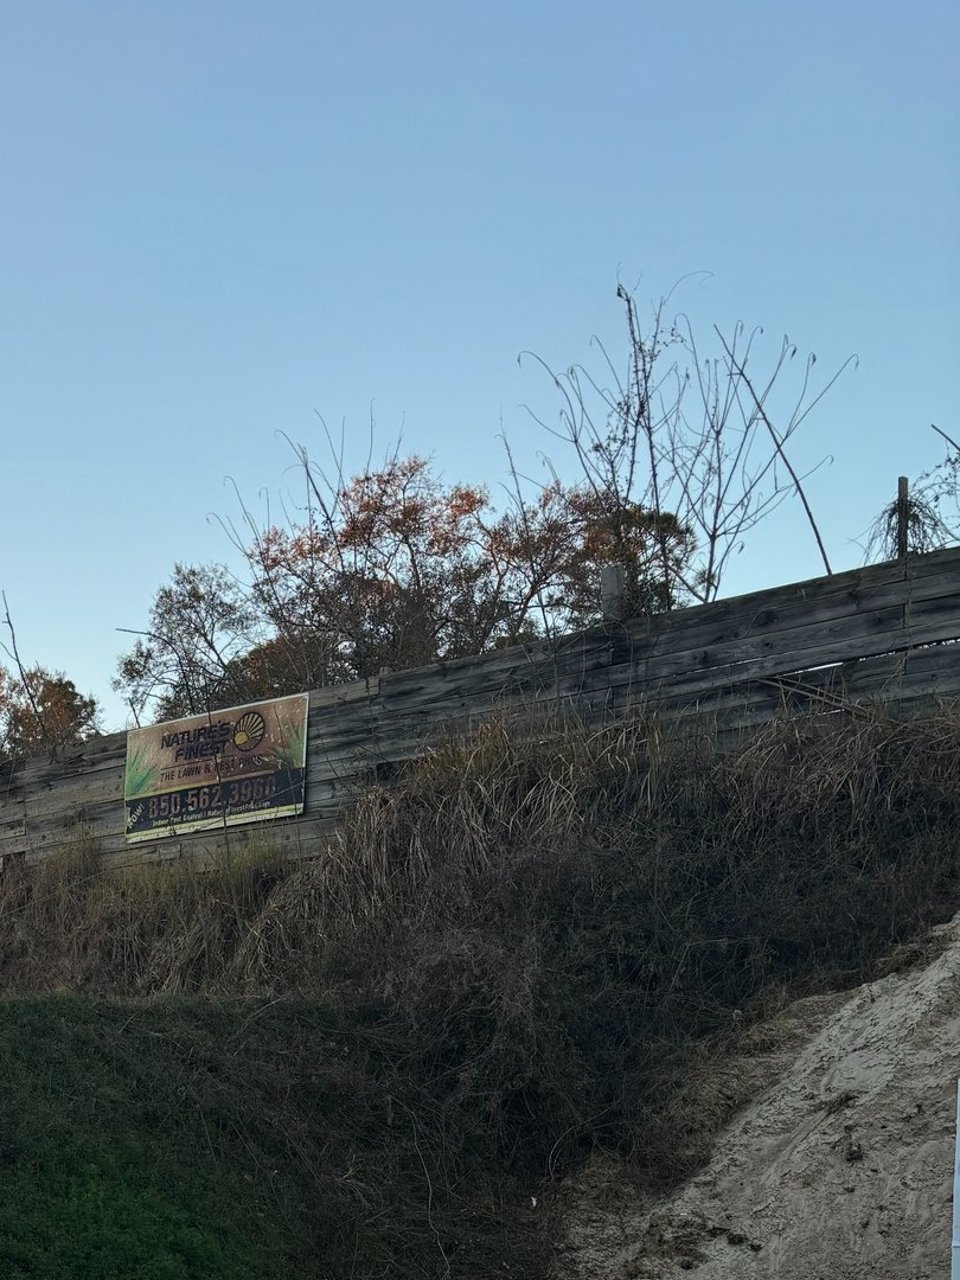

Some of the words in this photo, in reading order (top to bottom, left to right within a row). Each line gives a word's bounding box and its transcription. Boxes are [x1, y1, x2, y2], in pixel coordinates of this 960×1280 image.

[160, 720, 231, 750] NATURE'S
[175, 740, 231, 762] FINEST
[160, 770, 175, 782] THE
[178, 765, 201, 778] LAWN
[204, 764, 211, 774] &
